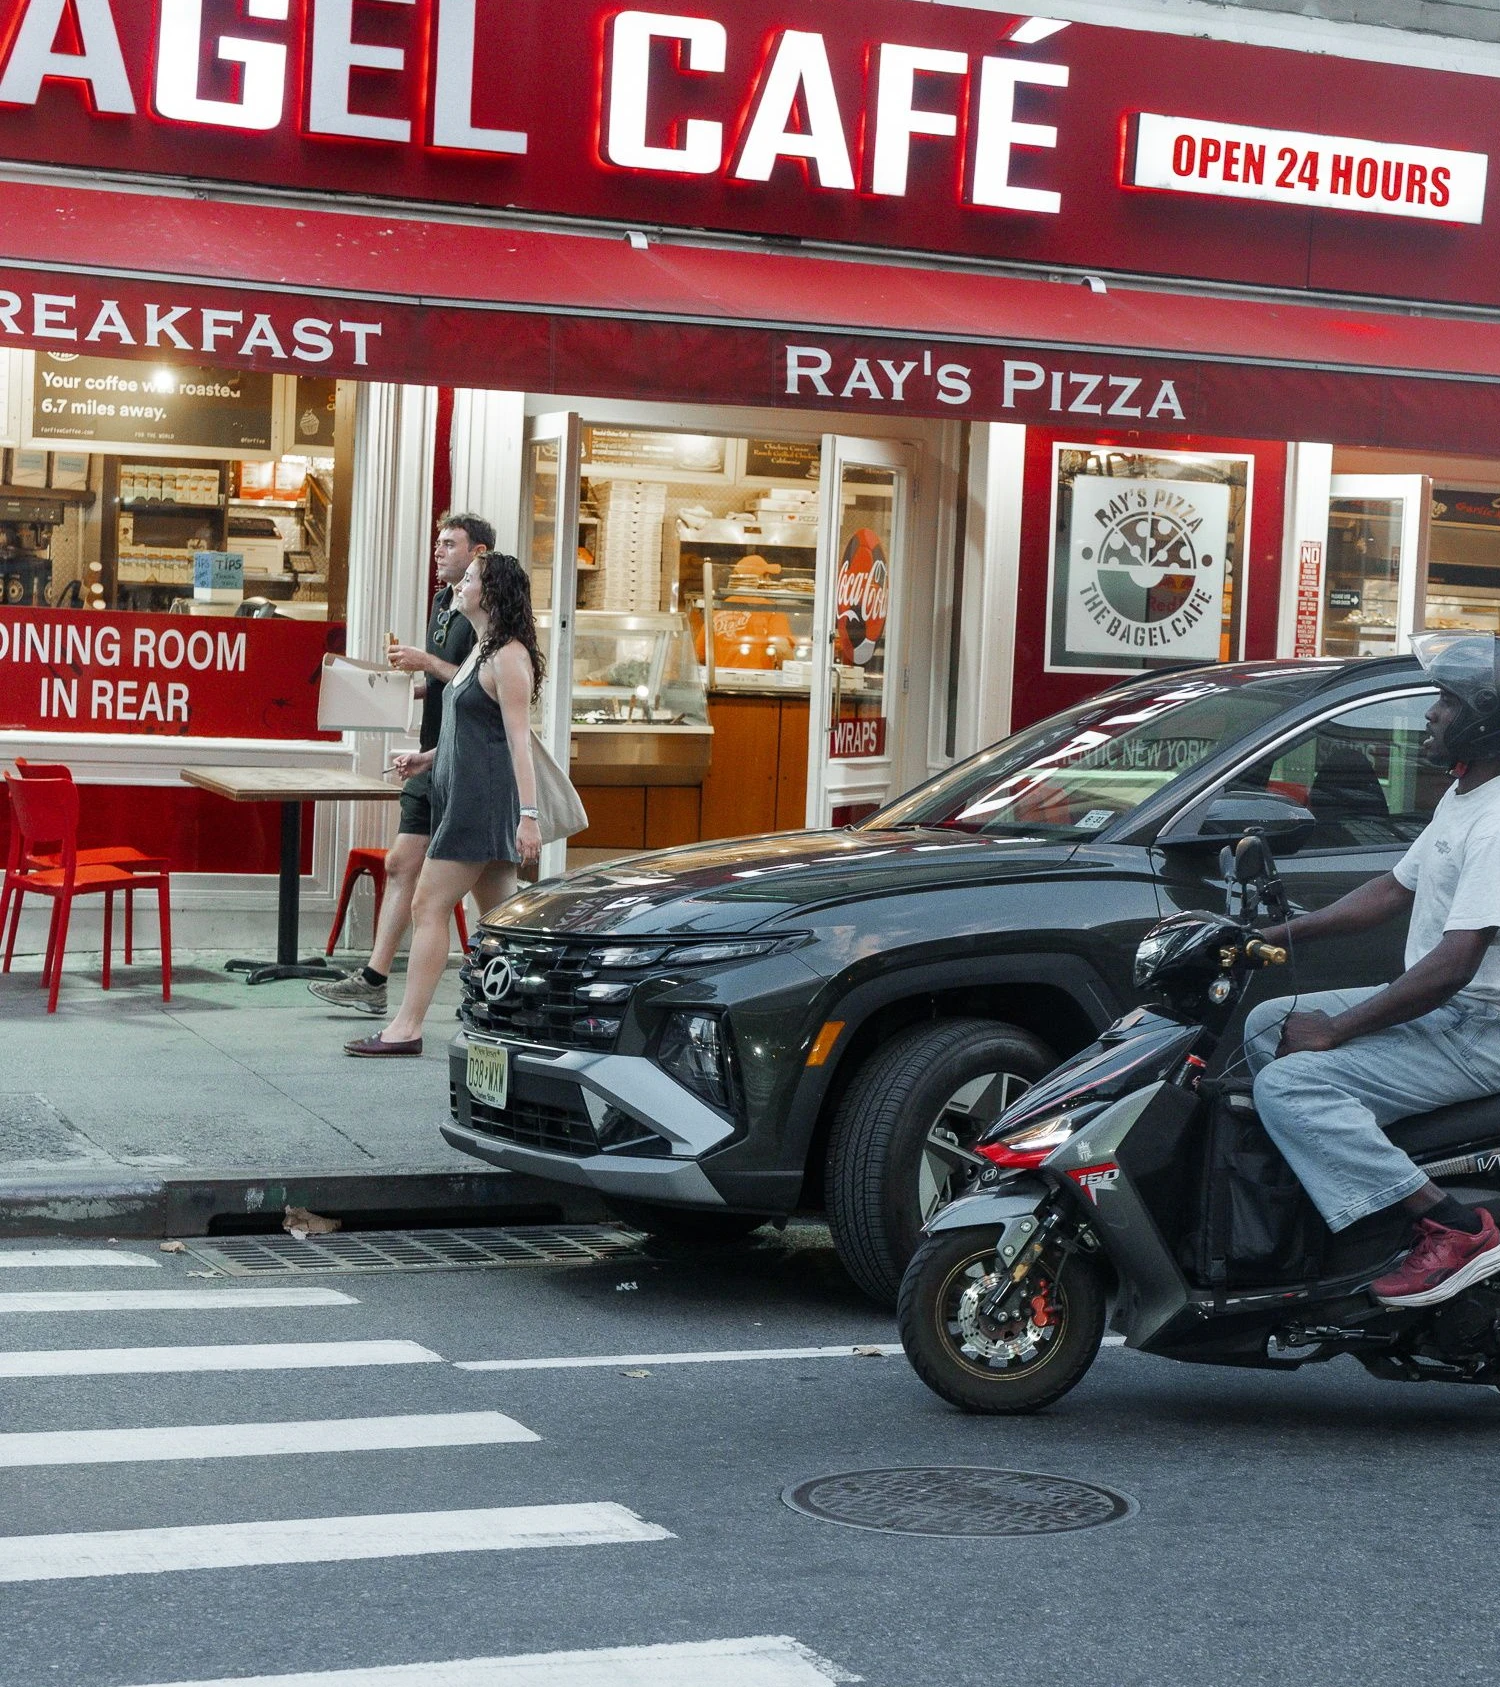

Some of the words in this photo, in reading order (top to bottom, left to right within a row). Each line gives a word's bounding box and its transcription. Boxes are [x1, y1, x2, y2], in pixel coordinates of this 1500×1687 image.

[608, 10, 1072, 215] CAFÉ
[1172, 134, 1265, 188] OPEN
[1276, 147, 1320, 192] 24
[1330, 153, 1450, 208] HOURS
[42, 372, 81, 389] Your
[85, 375, 137, 392] coffee
[142, 379, 174, 394] ws
[785, 346, 971, 403] RAY'S
[1002, 359, 1186, 420] PIZZA
[42, 398, 67, 414] 6.7
[71, 400, 115, 416] miles
[120, 405, 167, 422] away.
[1095, 488, 1147, 529] RAY'S
[1153, 488, 1203, 534] PIZZA
[1080, 582, 1110, 625] THE
[1106, 616, 1170, 647] BAGEL
[1172, 587, 1213, 637] CAFE
[133, 628, 247, 672] ROOM
[40, 678, 78, 718] IN
[90, 679, 190, 722] REAR
[834, 721, 877, 754] WRAPS
[1079, 1168, 1120, 1187] 150
